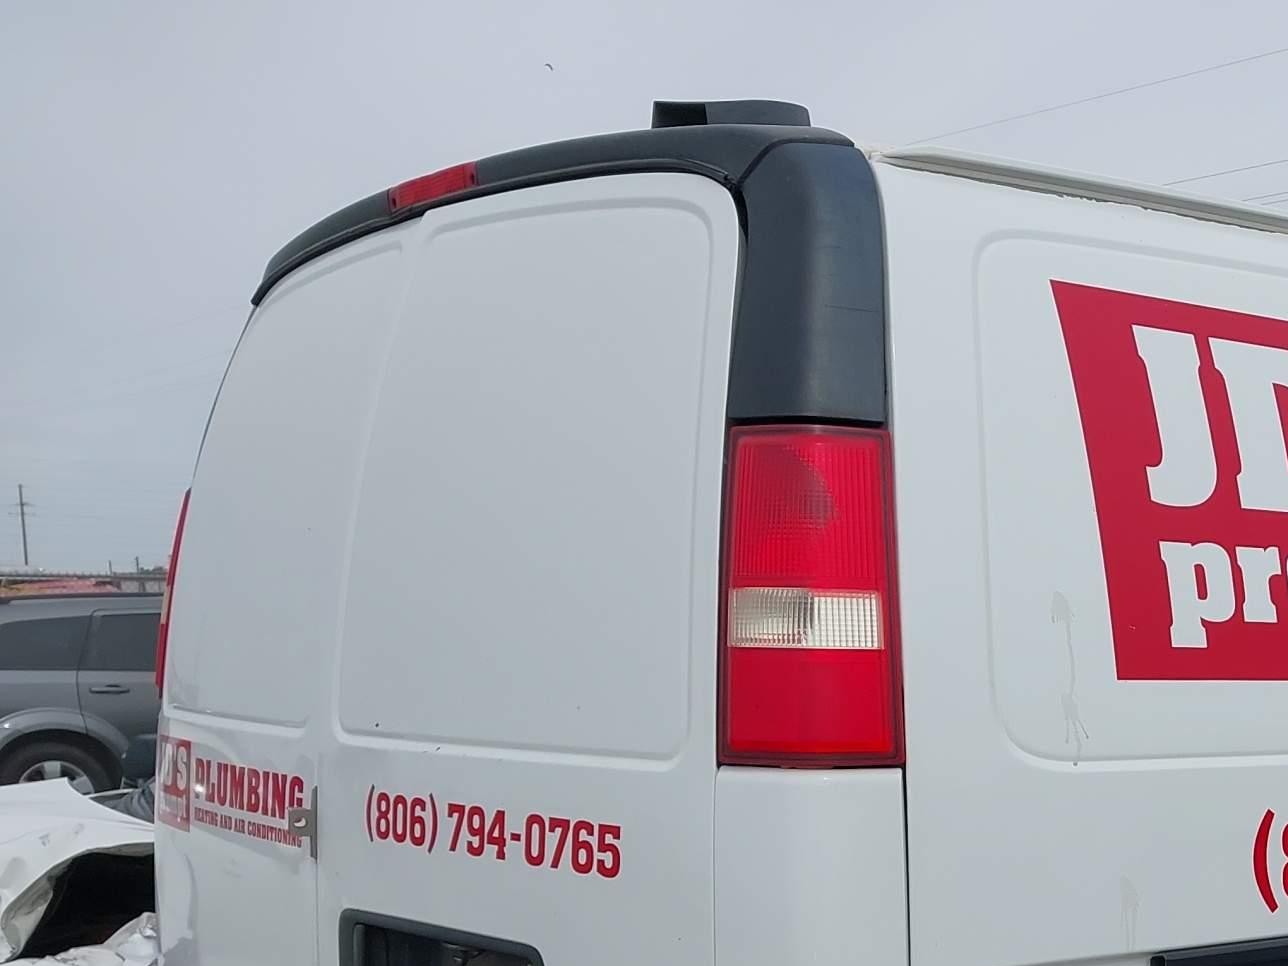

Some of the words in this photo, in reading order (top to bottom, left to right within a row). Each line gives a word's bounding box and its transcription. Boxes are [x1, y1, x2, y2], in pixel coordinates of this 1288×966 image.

[194, 757, 304, 819] PLUMBING
[194, 807, 219, 827] HEATING
[220, 813, 233, 831] AND
[234, 818, 246, 835] AIR
[364, 784, 439, 855] (806)
[446, 801, 623, 879] 794-0765
